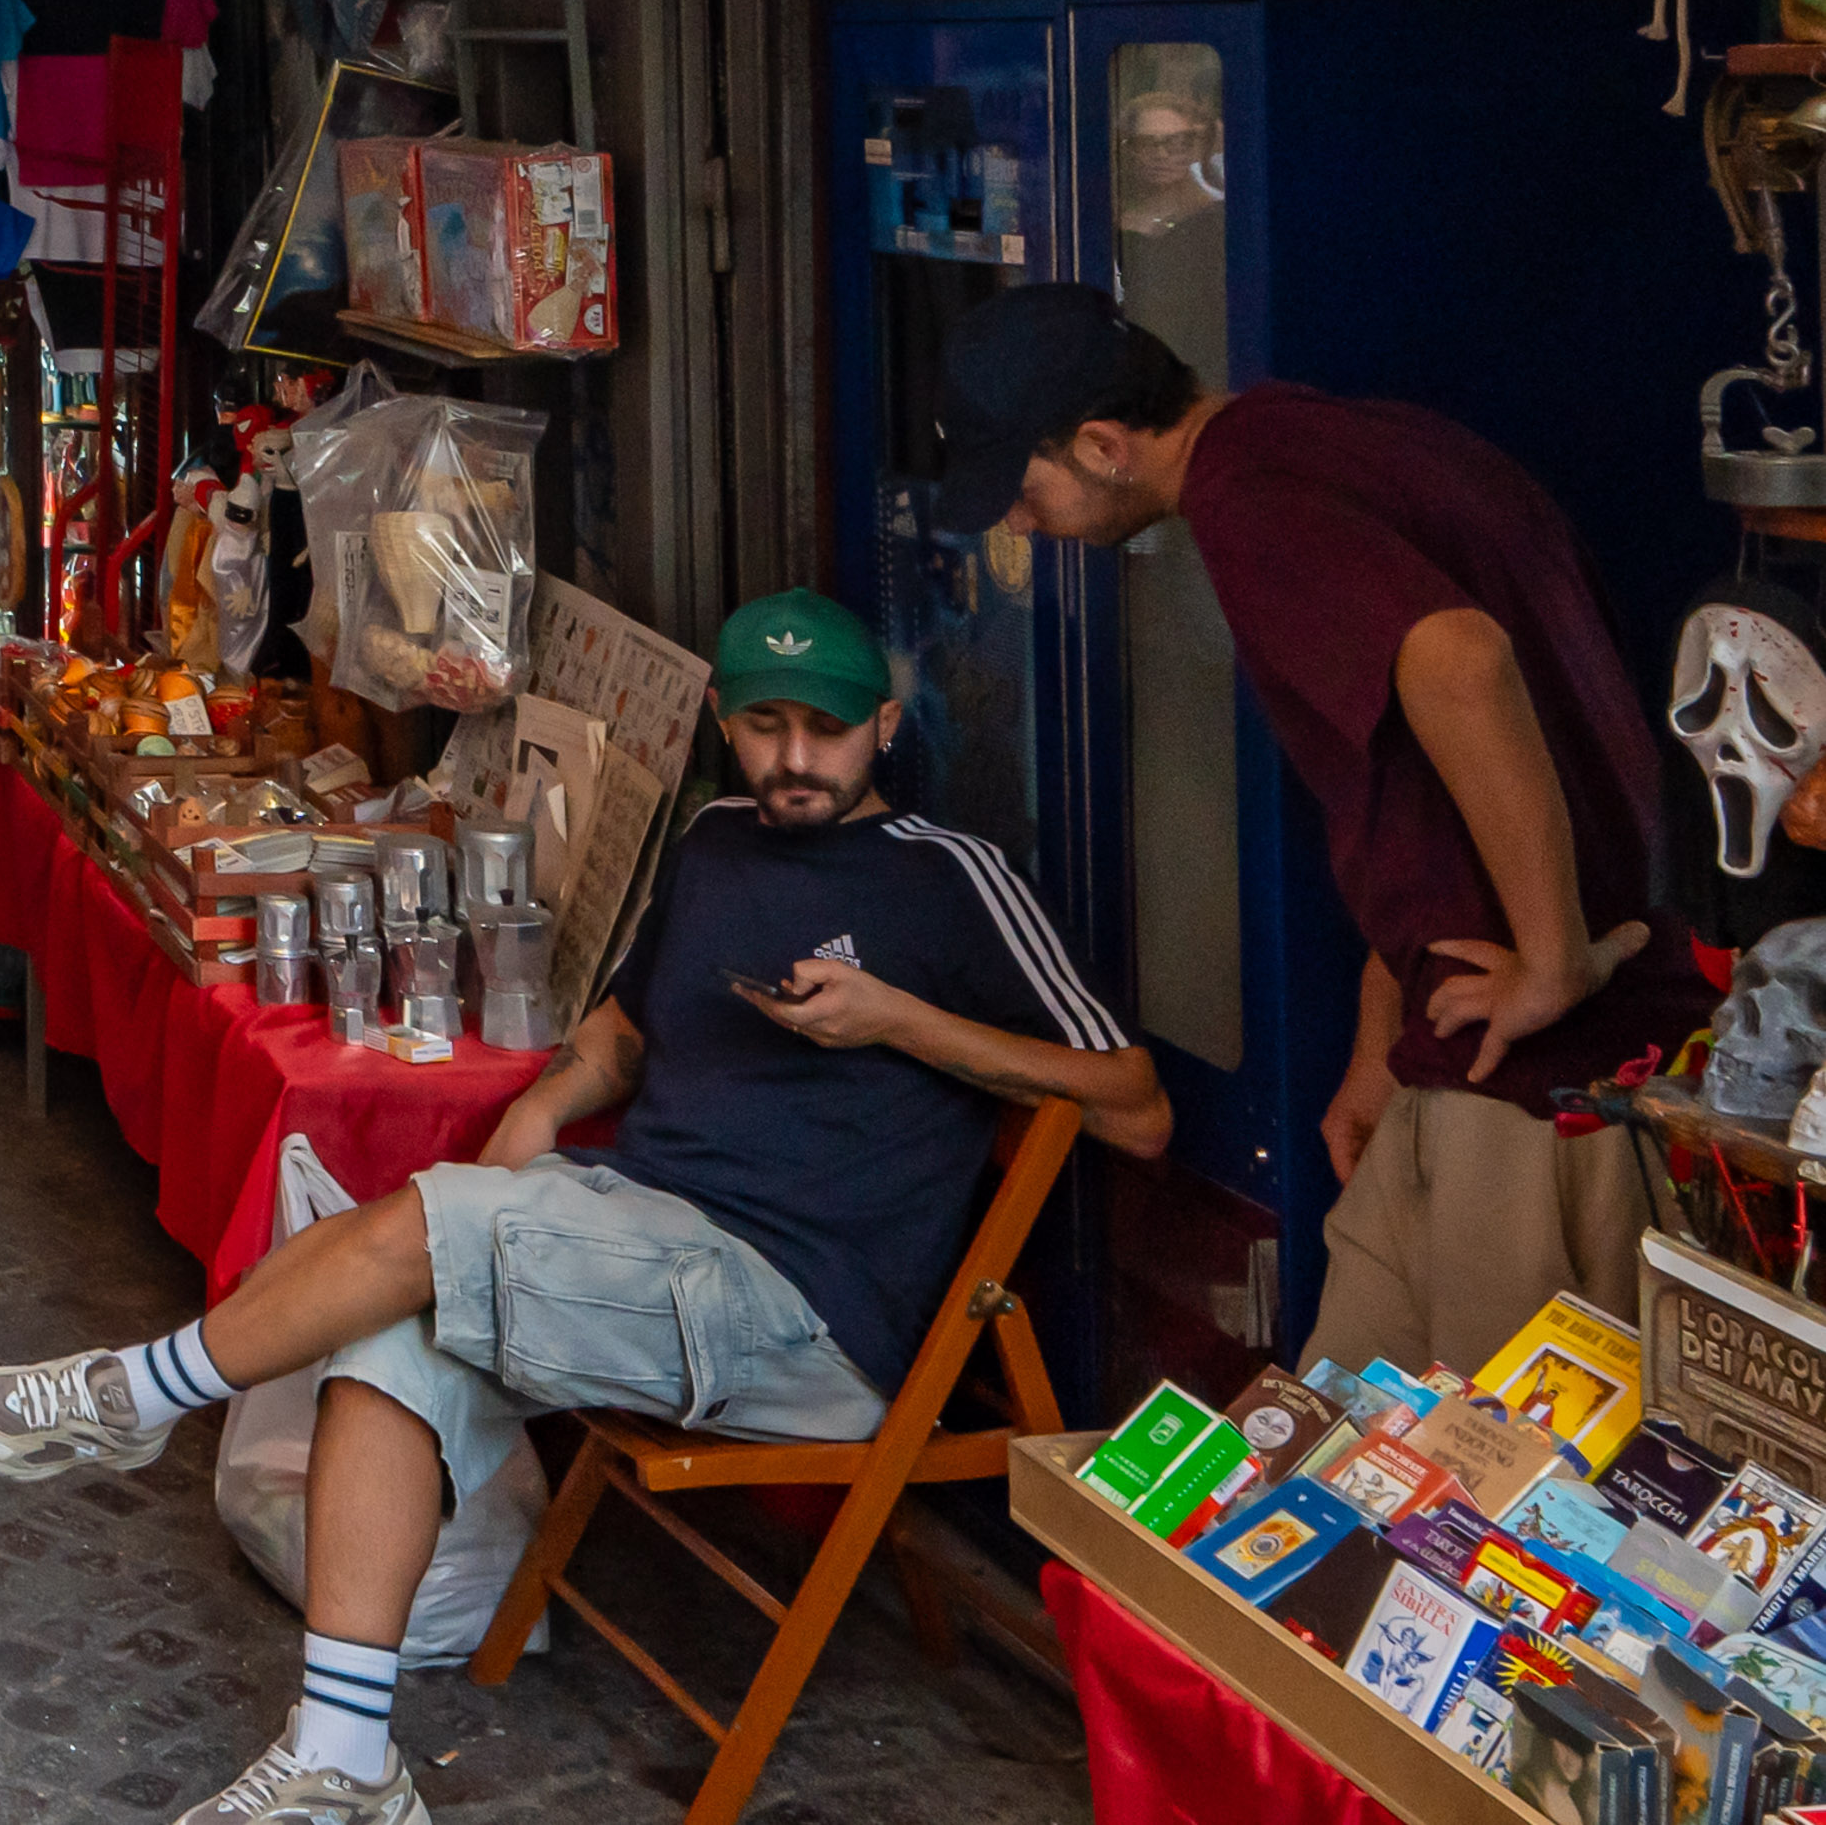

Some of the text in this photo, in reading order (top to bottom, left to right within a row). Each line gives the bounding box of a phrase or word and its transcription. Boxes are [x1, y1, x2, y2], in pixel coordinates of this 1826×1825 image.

[1681, 1328, 1733, 1376] DEI
[1610, 1468, 1689, 1526] TAROCCHI
[1390, 1585, 1451, 1637] SIBILLA
[1398, 1576, 1457, 1626] LA VERA
[1754, 1595, 1787, 1634] TAROT
